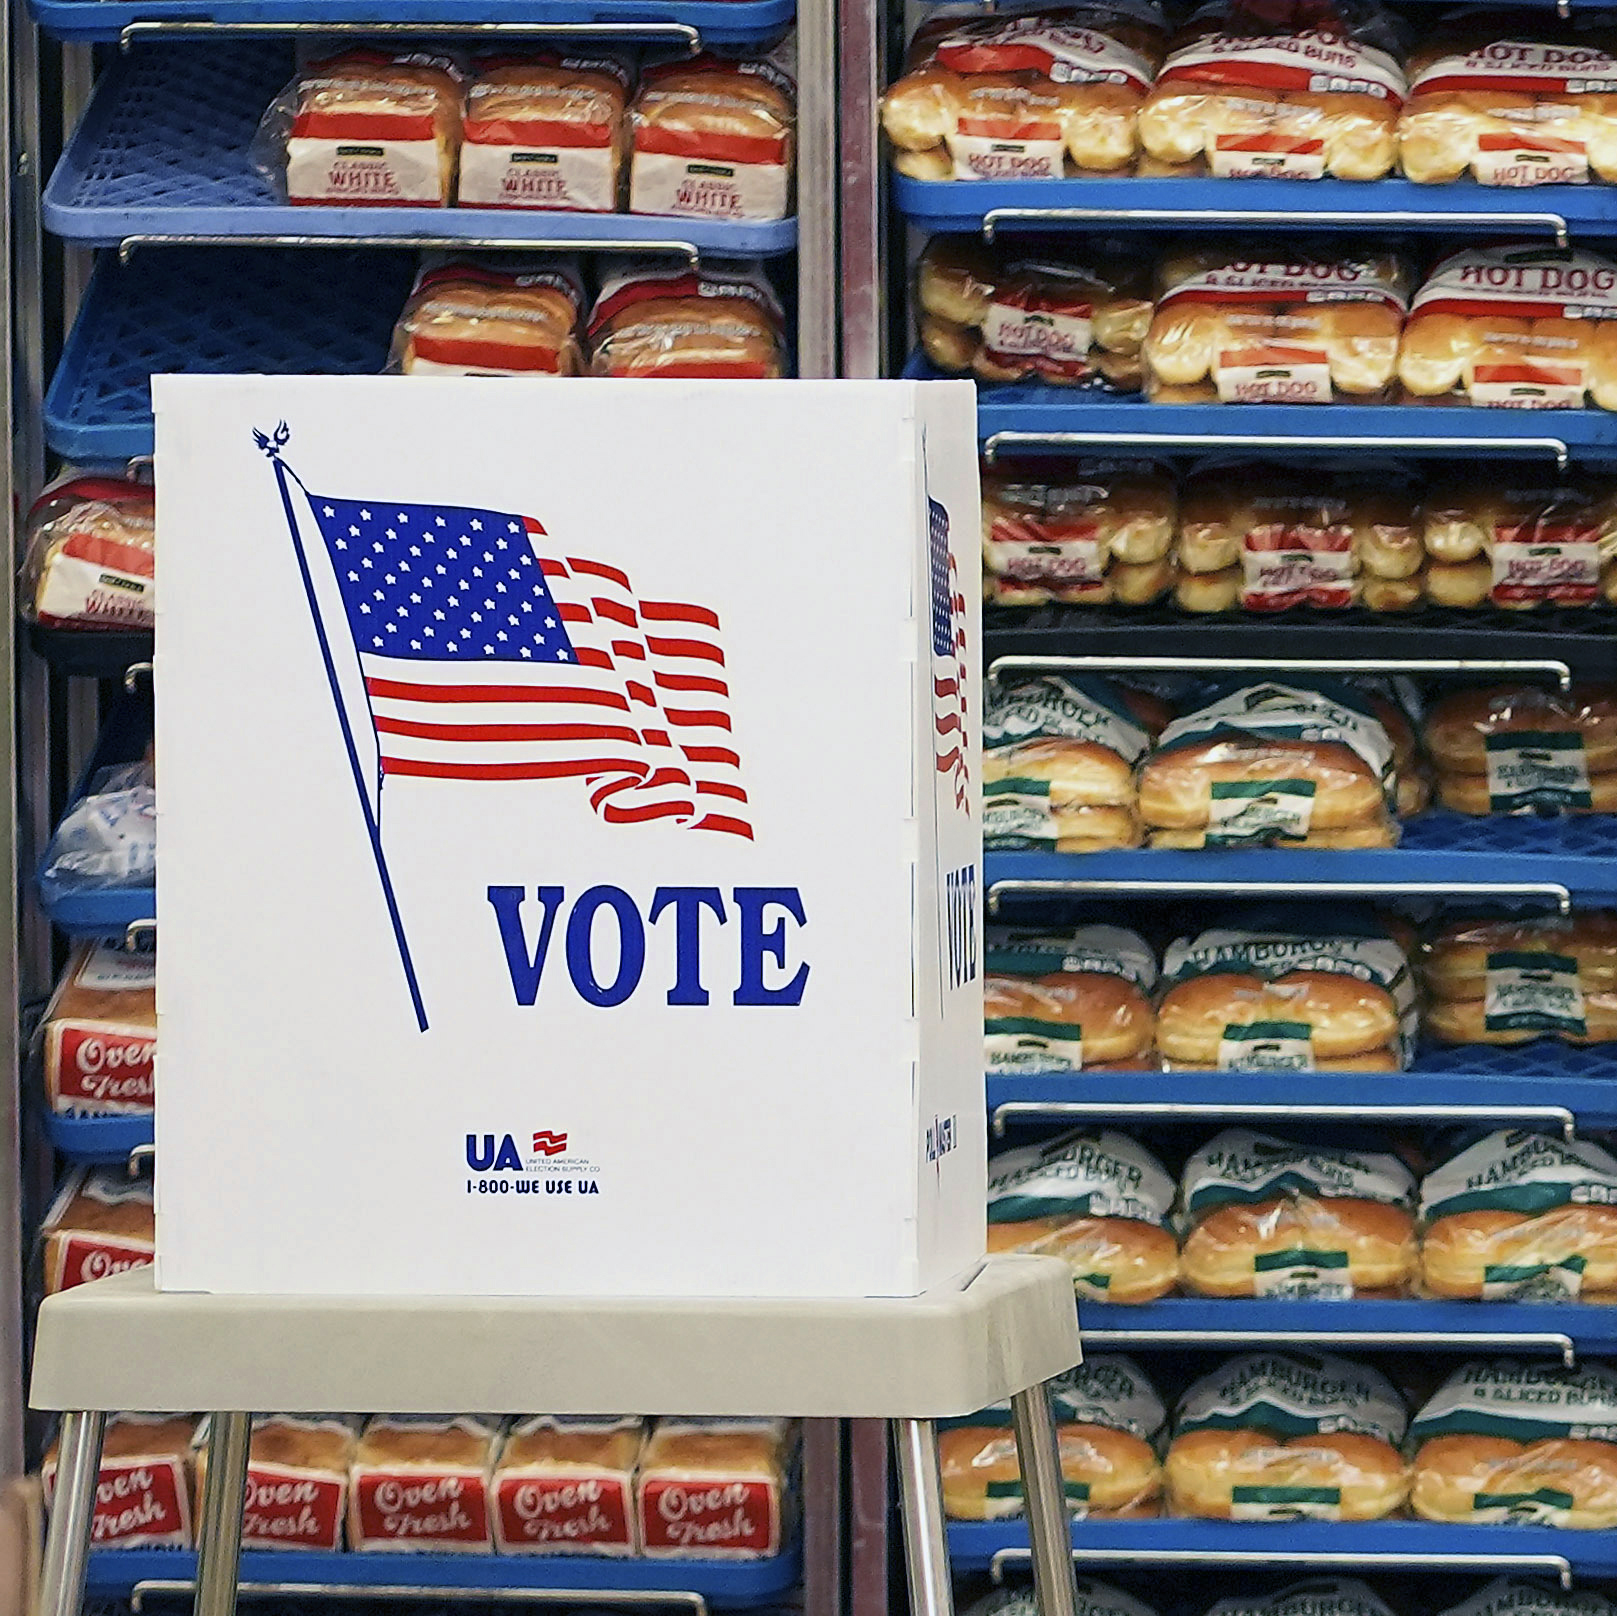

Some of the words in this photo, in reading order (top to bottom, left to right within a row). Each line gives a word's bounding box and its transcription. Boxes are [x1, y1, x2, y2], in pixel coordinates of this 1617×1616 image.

[328, 170, 397, 190] WHITE
[502, 177, 567, 196] WHITE
[1493, 166, 1530, 182] HOT
[676, 189, 742, 208] WHITE
[1460, 264, 1529, 288] HOT
[1537, 267, 1617, 292] DOG
[945, 863, 977, 991] VOTE
[487, 886, 811, 1007] VOTE
[466, 1133, 524, 1172] UA
[525, 1165, 560, 1173] ELECTION
[561, 1165, 588, 1173] SUPPLY
[467, 1179, 540, 1194] 1-800-WE
[545, 1179, 573, 1194] USE
[578, 1179, 600, 1194] UA
[95, 1469, 154, 1500] ven
[375, 1476, 462, 1511] Oven
[513, 1479, 602, 1514] Oven
[658, 1482, 747, 1519] Oven
